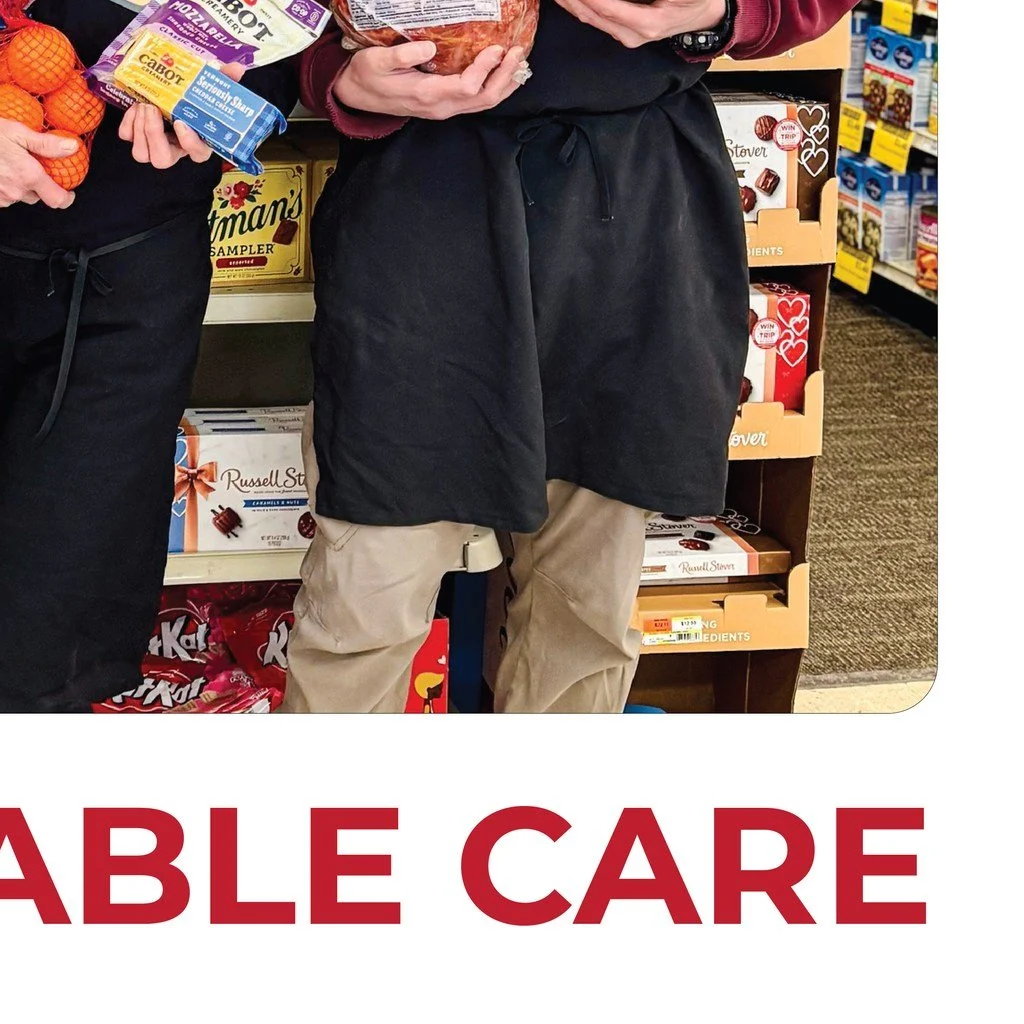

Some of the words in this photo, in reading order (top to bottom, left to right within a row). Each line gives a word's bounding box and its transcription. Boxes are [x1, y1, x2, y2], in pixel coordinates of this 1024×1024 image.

[170, 1, 243, 50] MOZZARELLA
[160, 26, 189, 45] CLASSIC
[191, 43, 206, 55] CUT
[141, 65, 172, 87] CREAMERY
[203, 70, 231, 89] VERMONT
[192, 86, 218, 105] CHEDDAR
[215, 99, 236, 116] CHEESE
[196, 76, 232, 104] Seriously
[230, 95, 255, 118] Sharp
[210, 244, 274, 257] SAMPLER
[759, 331, 775, 339] TRIP
[220, 468, 282, 494] Russell
[679, 562, 710, 574] Russell
[710, 560, 735, 572] Stover
